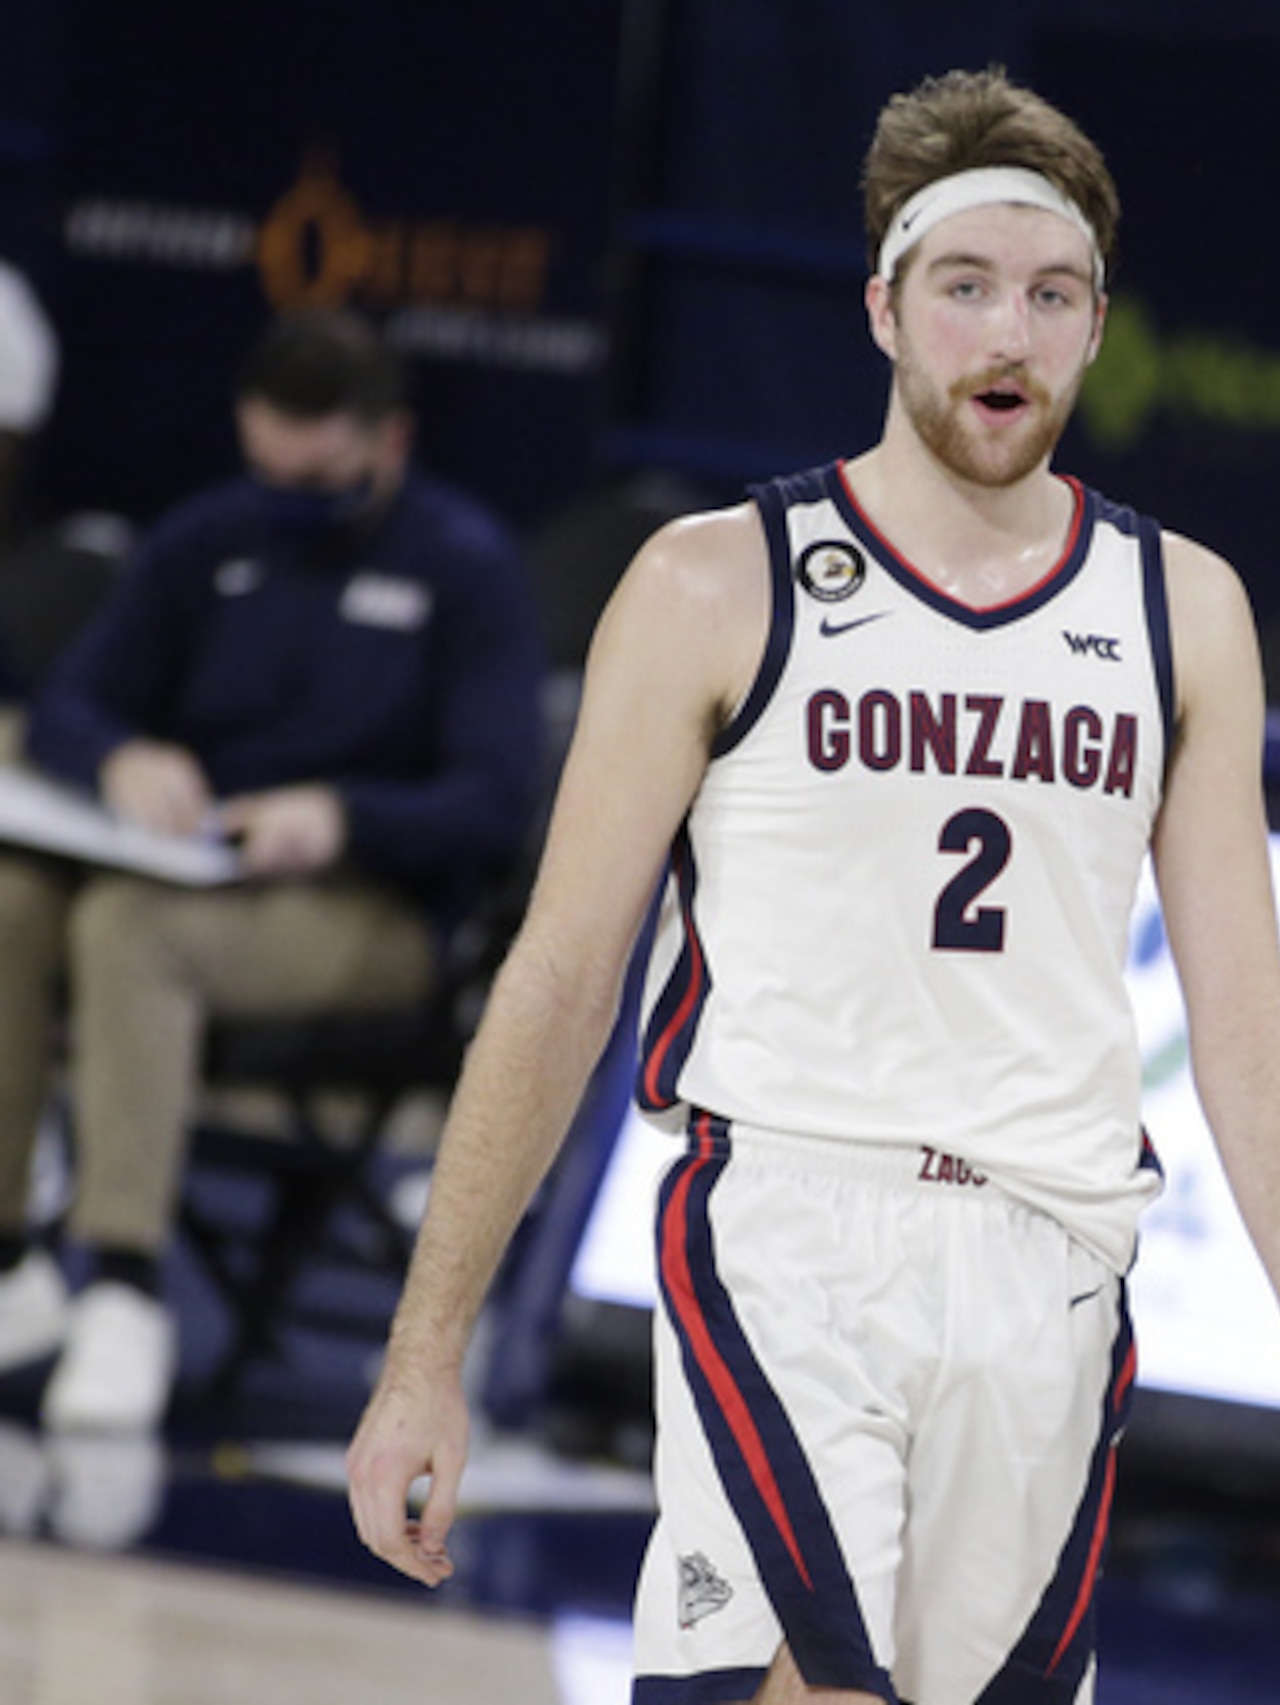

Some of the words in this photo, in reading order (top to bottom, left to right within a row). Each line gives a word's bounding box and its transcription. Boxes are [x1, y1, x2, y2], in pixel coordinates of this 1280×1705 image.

[1062, 630, 1122, 662] WCC
[806, 688, 1138, 799] GONZAGA
[931, 807, 1012, 952] 2
